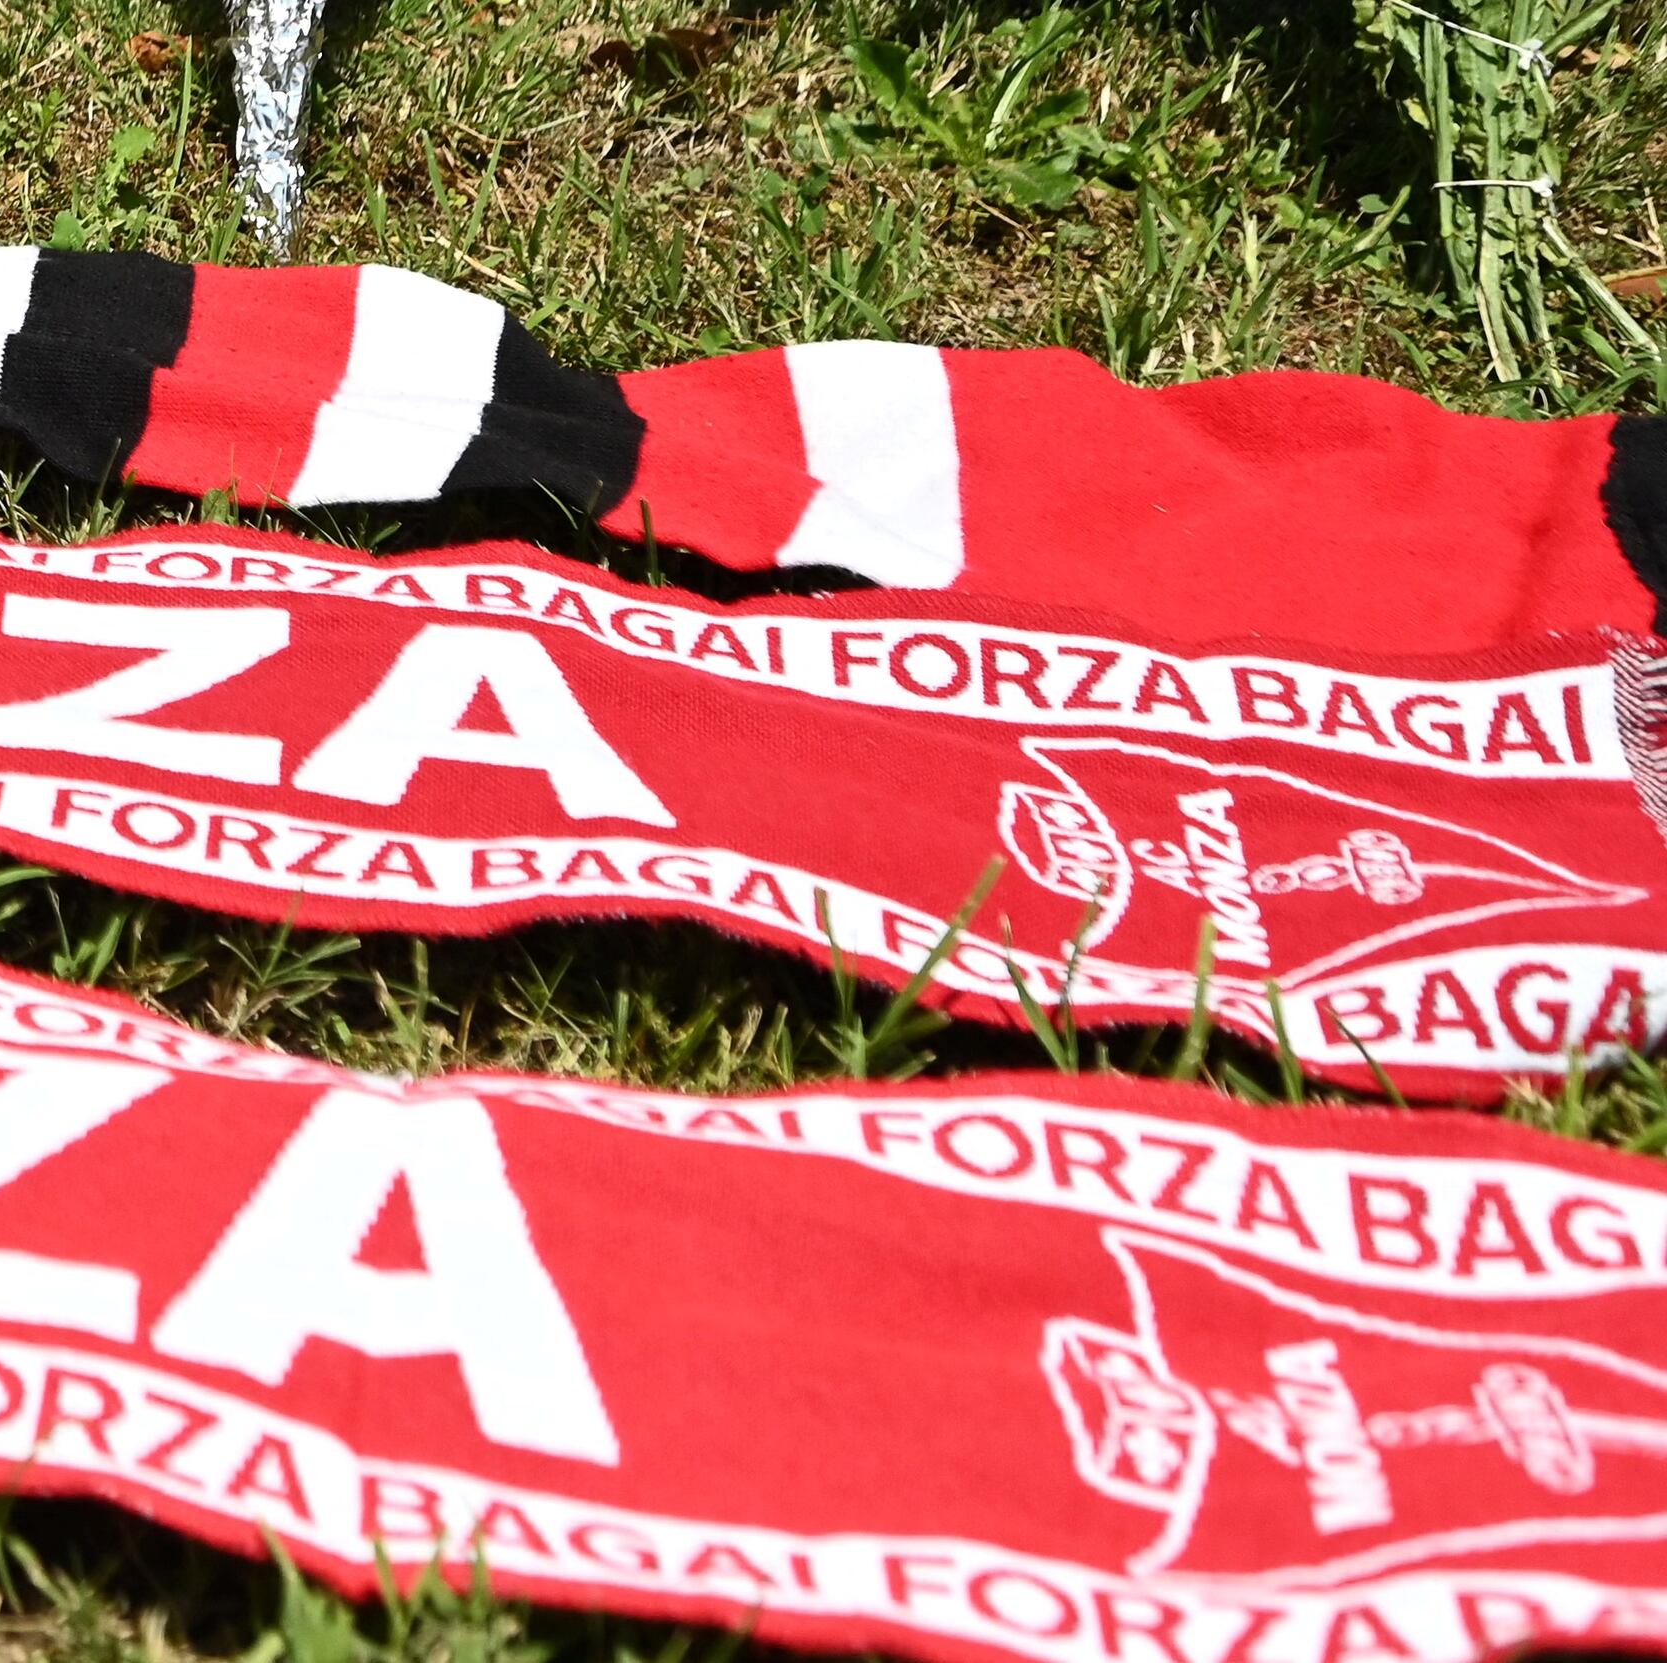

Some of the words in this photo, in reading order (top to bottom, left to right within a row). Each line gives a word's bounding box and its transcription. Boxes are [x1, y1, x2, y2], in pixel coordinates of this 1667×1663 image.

[92, 551, 436, 604] FORZA
[465, 572, 786, 676] BAGAI
[831, 630, 1211, 726] FORZA
[1230, 665, 1593, 765] BAGAI
[49, 788, 438, 890] FORZA
[1130, 838, 1203, 898] AC
[1175, 787, 1272, 969] MONZA
[1314, 961, 1649, 1055] BAGA
[858, 1110, 1323, 1254] FORZA
[1347, 1172, 1645, 1278] BAG
[360, 1474, 819, 1593] BAGAI
